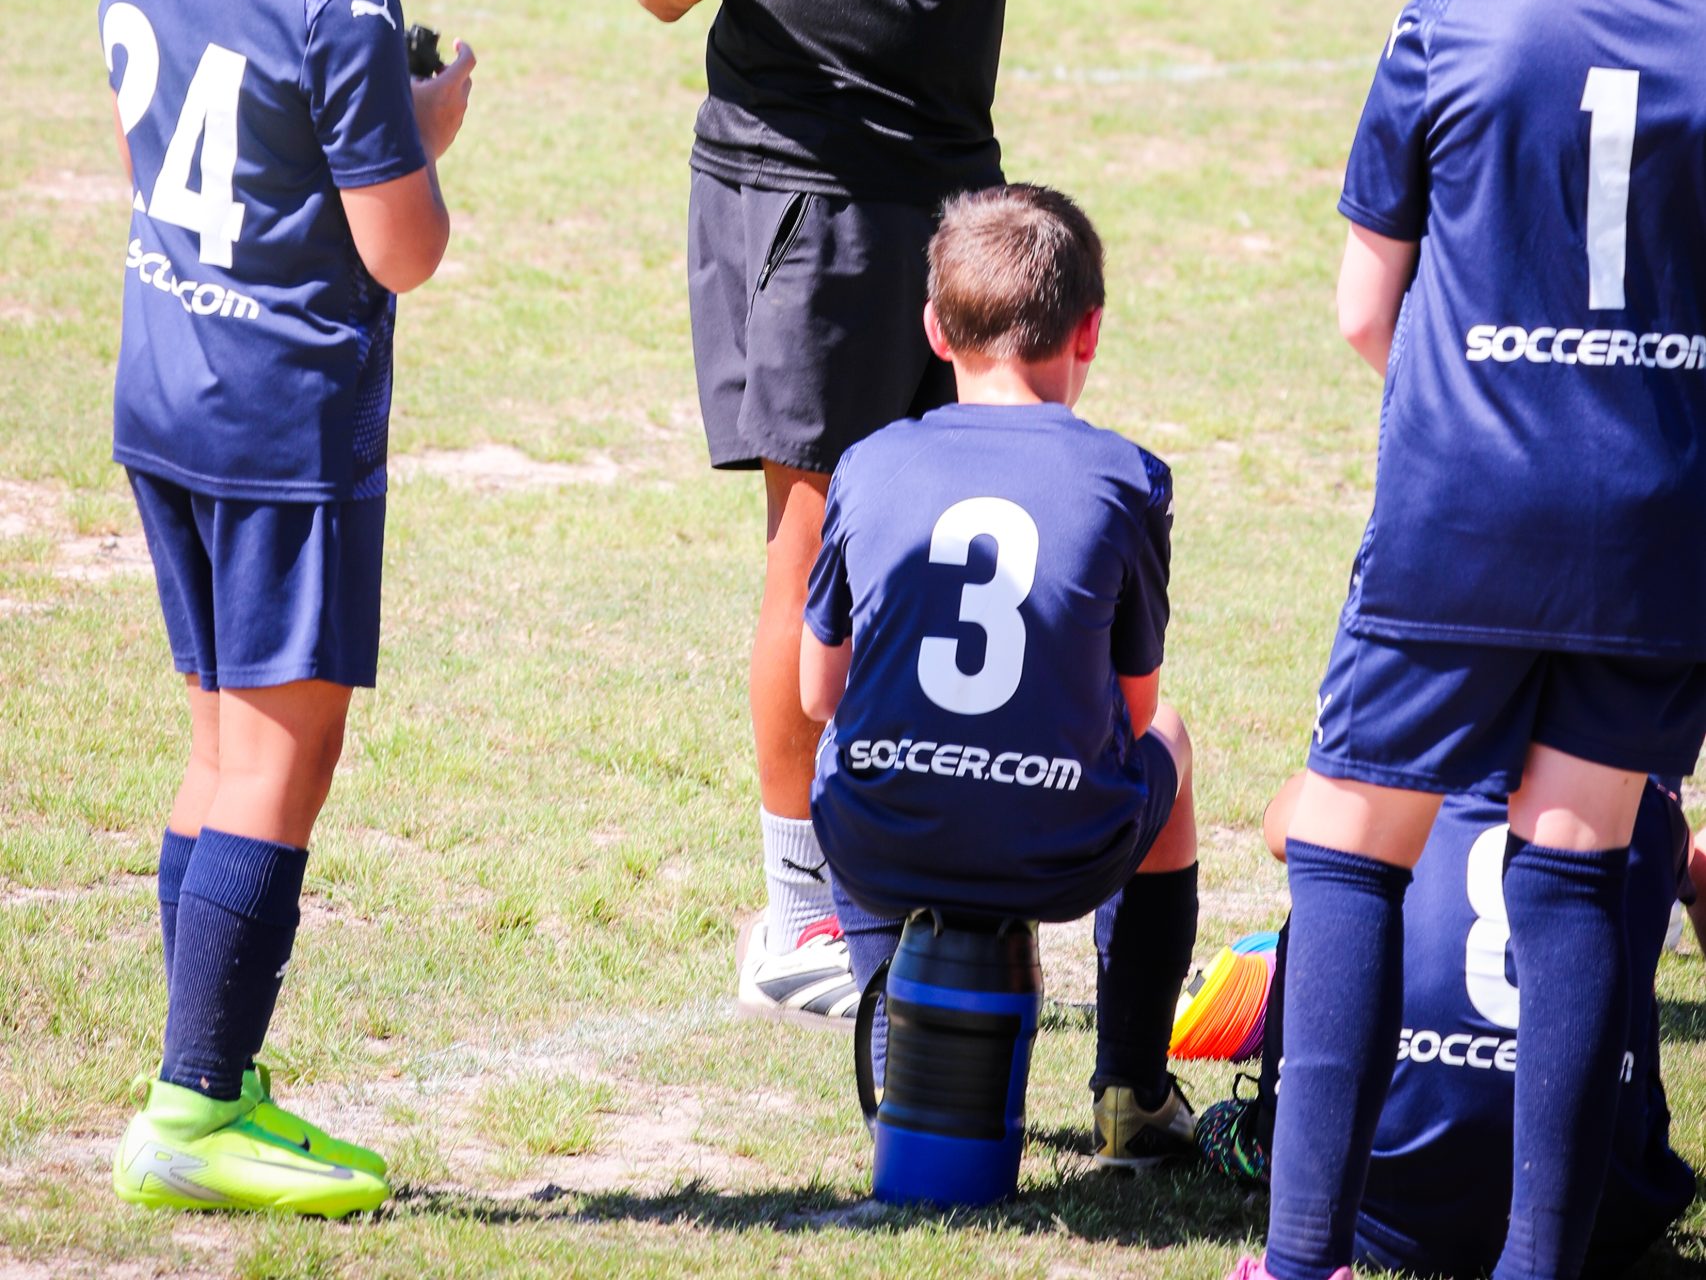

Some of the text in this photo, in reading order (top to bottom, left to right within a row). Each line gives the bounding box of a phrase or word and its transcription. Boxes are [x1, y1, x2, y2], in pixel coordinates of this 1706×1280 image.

[103, 2, 247, 269] 24
[1580, 66, 1640, 310] 1
[917, 497, 1039, 715] 3
[850, 739, 1082, 791] SOCCER.COM
